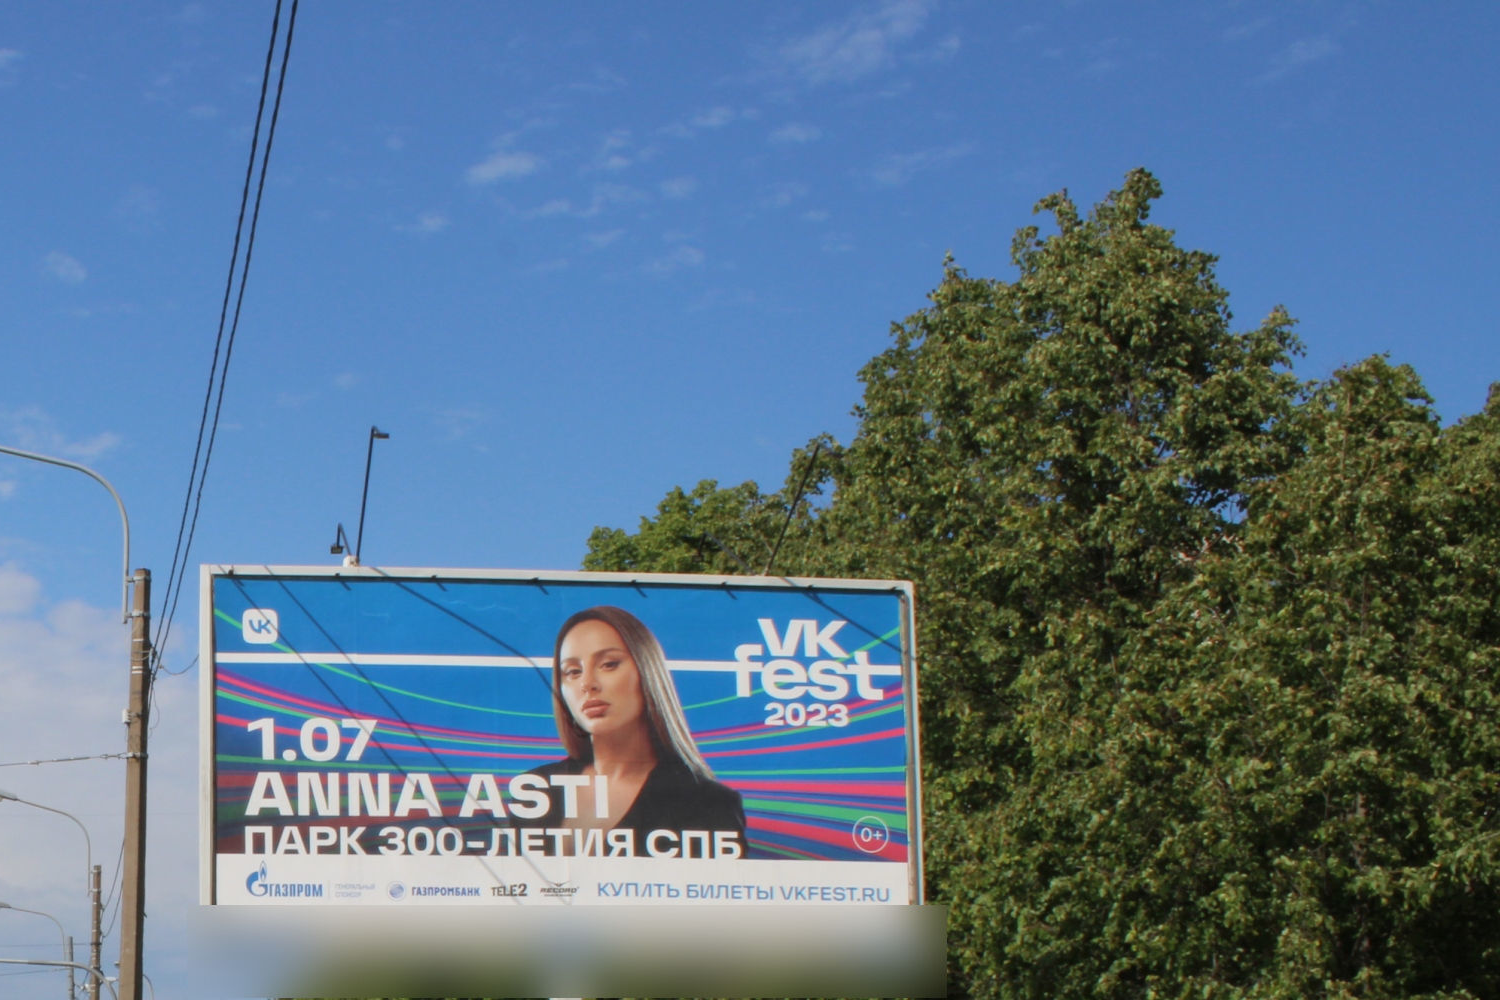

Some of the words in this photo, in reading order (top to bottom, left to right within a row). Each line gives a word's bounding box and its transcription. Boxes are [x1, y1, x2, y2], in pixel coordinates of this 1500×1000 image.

[756, 618, 850, 658] VK
[734, 643, 884, 701] fest
[763, 702, 850, 728] 2023
[247, 717, 378, 761] 1.07
[244, 771, 444, 818] ANNA
[458, 773, 610, 820] ASTI
[244, 825, 367, 856] ПАРК
[378, 826, 634, 859] 300-ЛЕТИЯ
[645, 830, 741, 860] СПБ
[861, 827, 883, 842] 0+
[268, 883, 323, 898] ГАЗПРОМ
[411, 885, 481, 897] ГАЗПРОМБАНК
[491, 883, 527, 897] TELE2
[597, 882, 680, 898] КУПИТЬ
[686, 884, 774, 900] БИЛЕТЫ
[780, 886, 891, 902] VKFEST.RU
